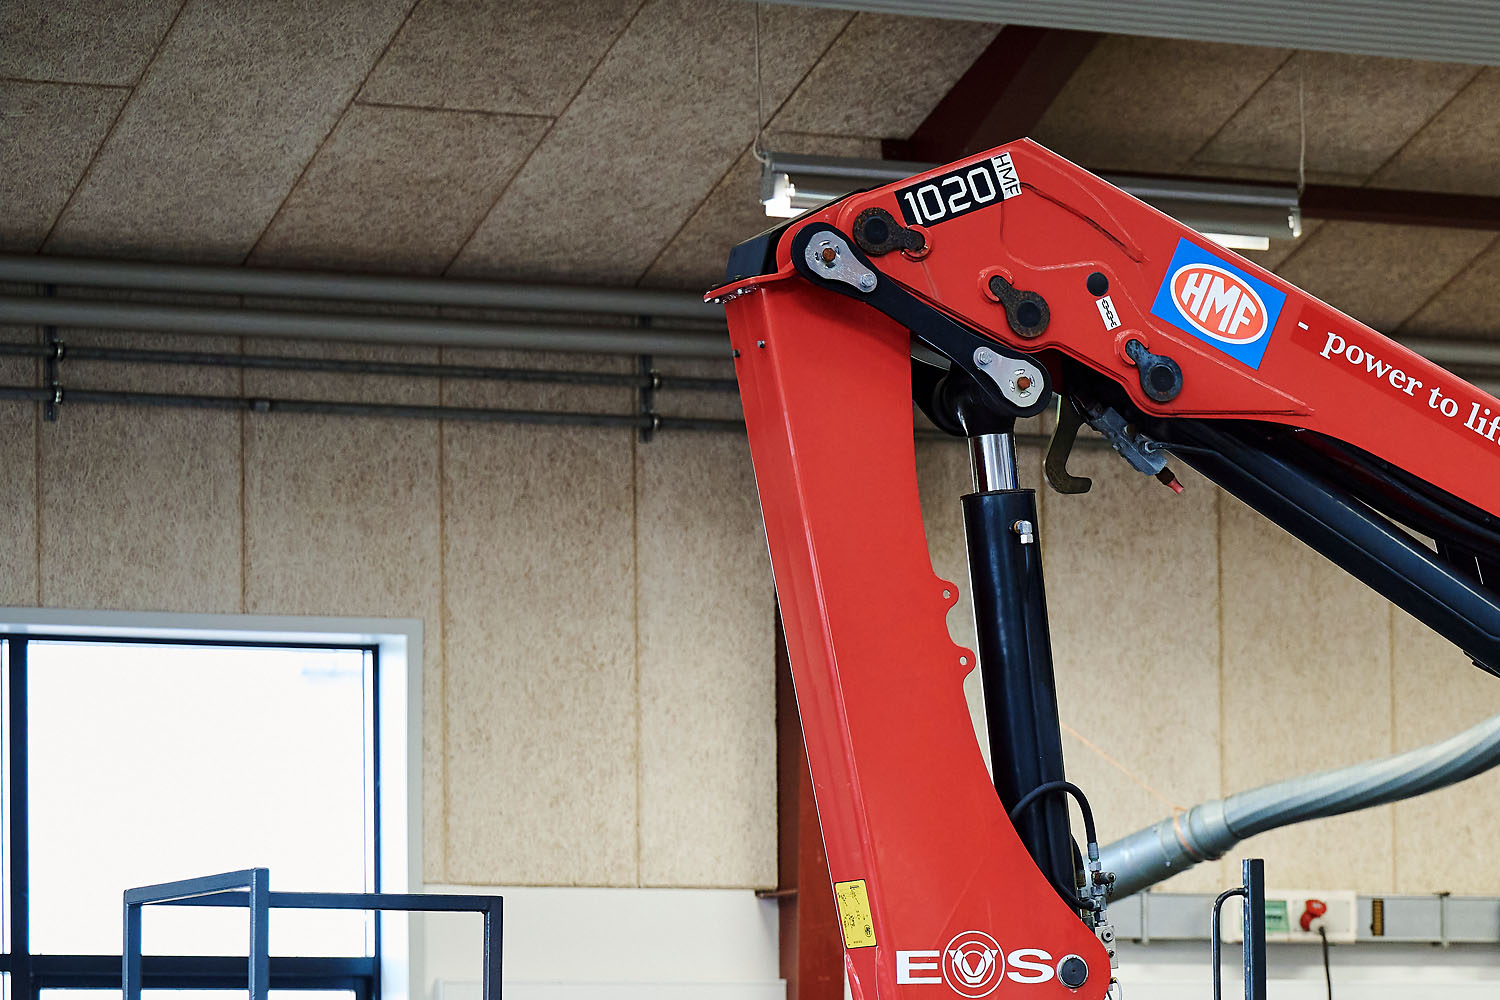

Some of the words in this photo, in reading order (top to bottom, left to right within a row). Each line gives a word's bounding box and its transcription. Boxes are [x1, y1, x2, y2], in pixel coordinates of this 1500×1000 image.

[904, 166, 997, 225] 1020
[994, 153, 1020, 195] HMF
[1180, 272, 1257, 336] HMF
[1319, 331, 1423, 397] power
[1428, 386, 1459, 418] to
